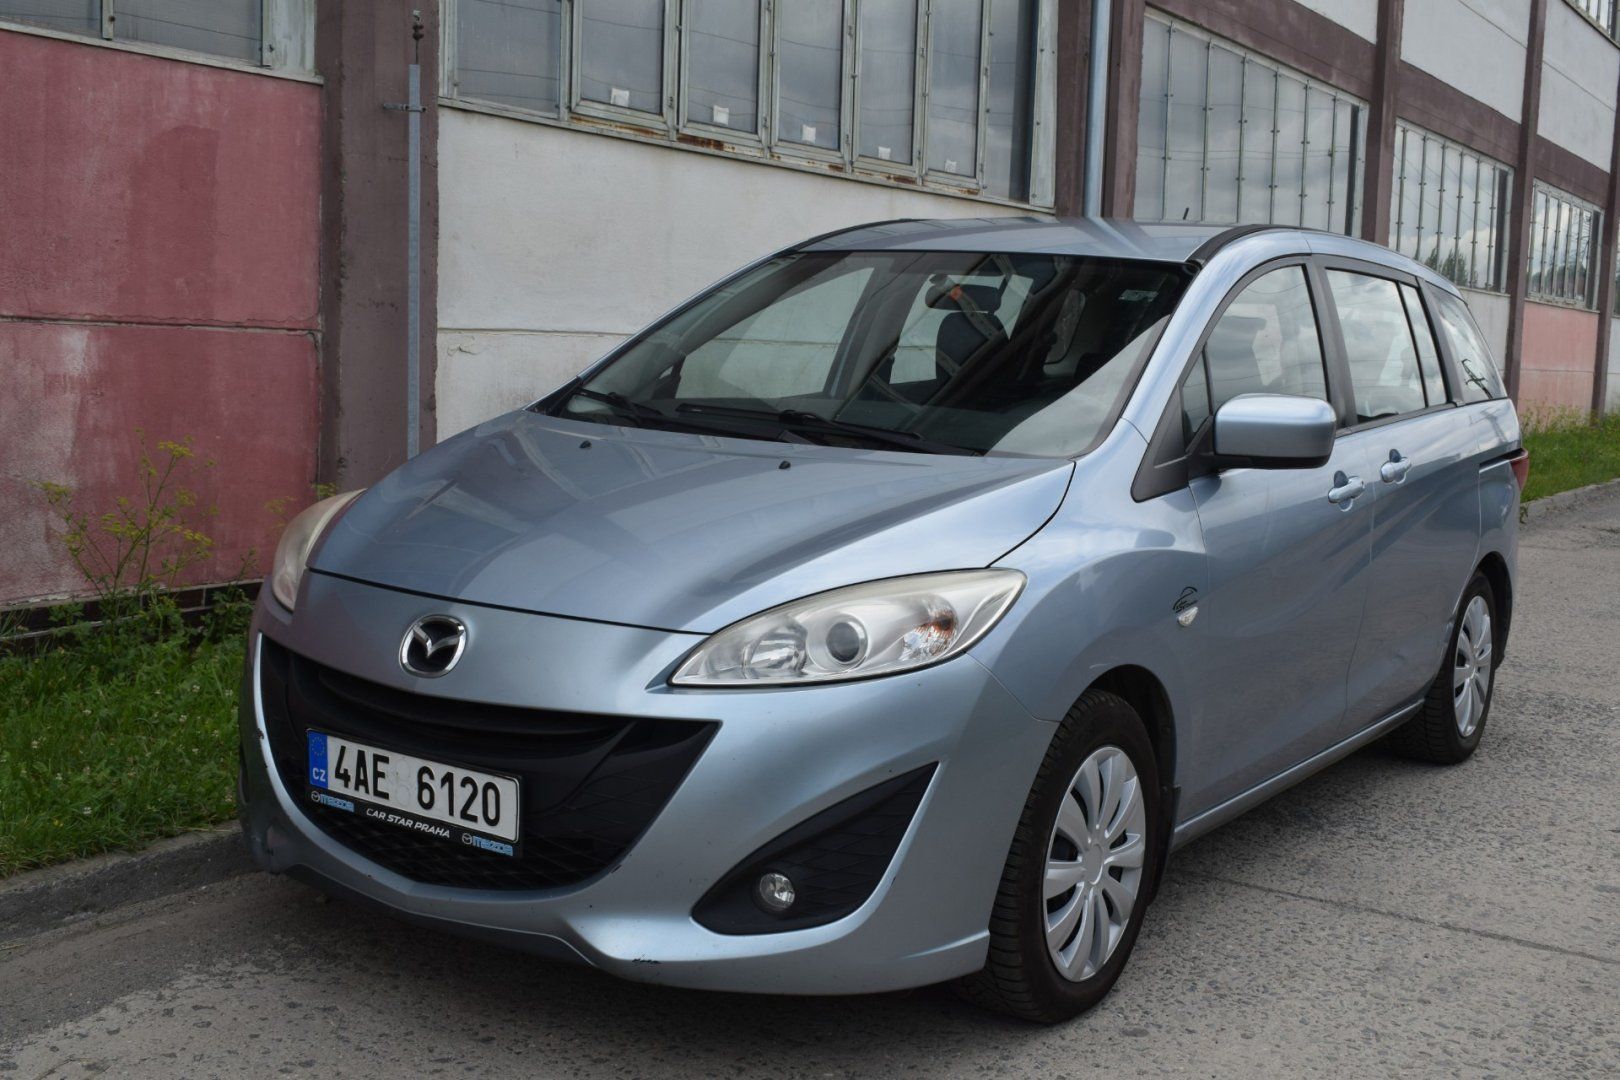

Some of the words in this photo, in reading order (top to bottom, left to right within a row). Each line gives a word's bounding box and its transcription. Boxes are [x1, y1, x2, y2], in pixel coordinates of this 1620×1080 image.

[312, 767, 326, 782] CZ
[334, 745, 390, 800] 4AE
[417, 765, 501, 827] 6120
[366, 808, 386, 820] CAR
[387, 814, 413, 829] STAR
[414, 822, 450, 838] PRAHA
